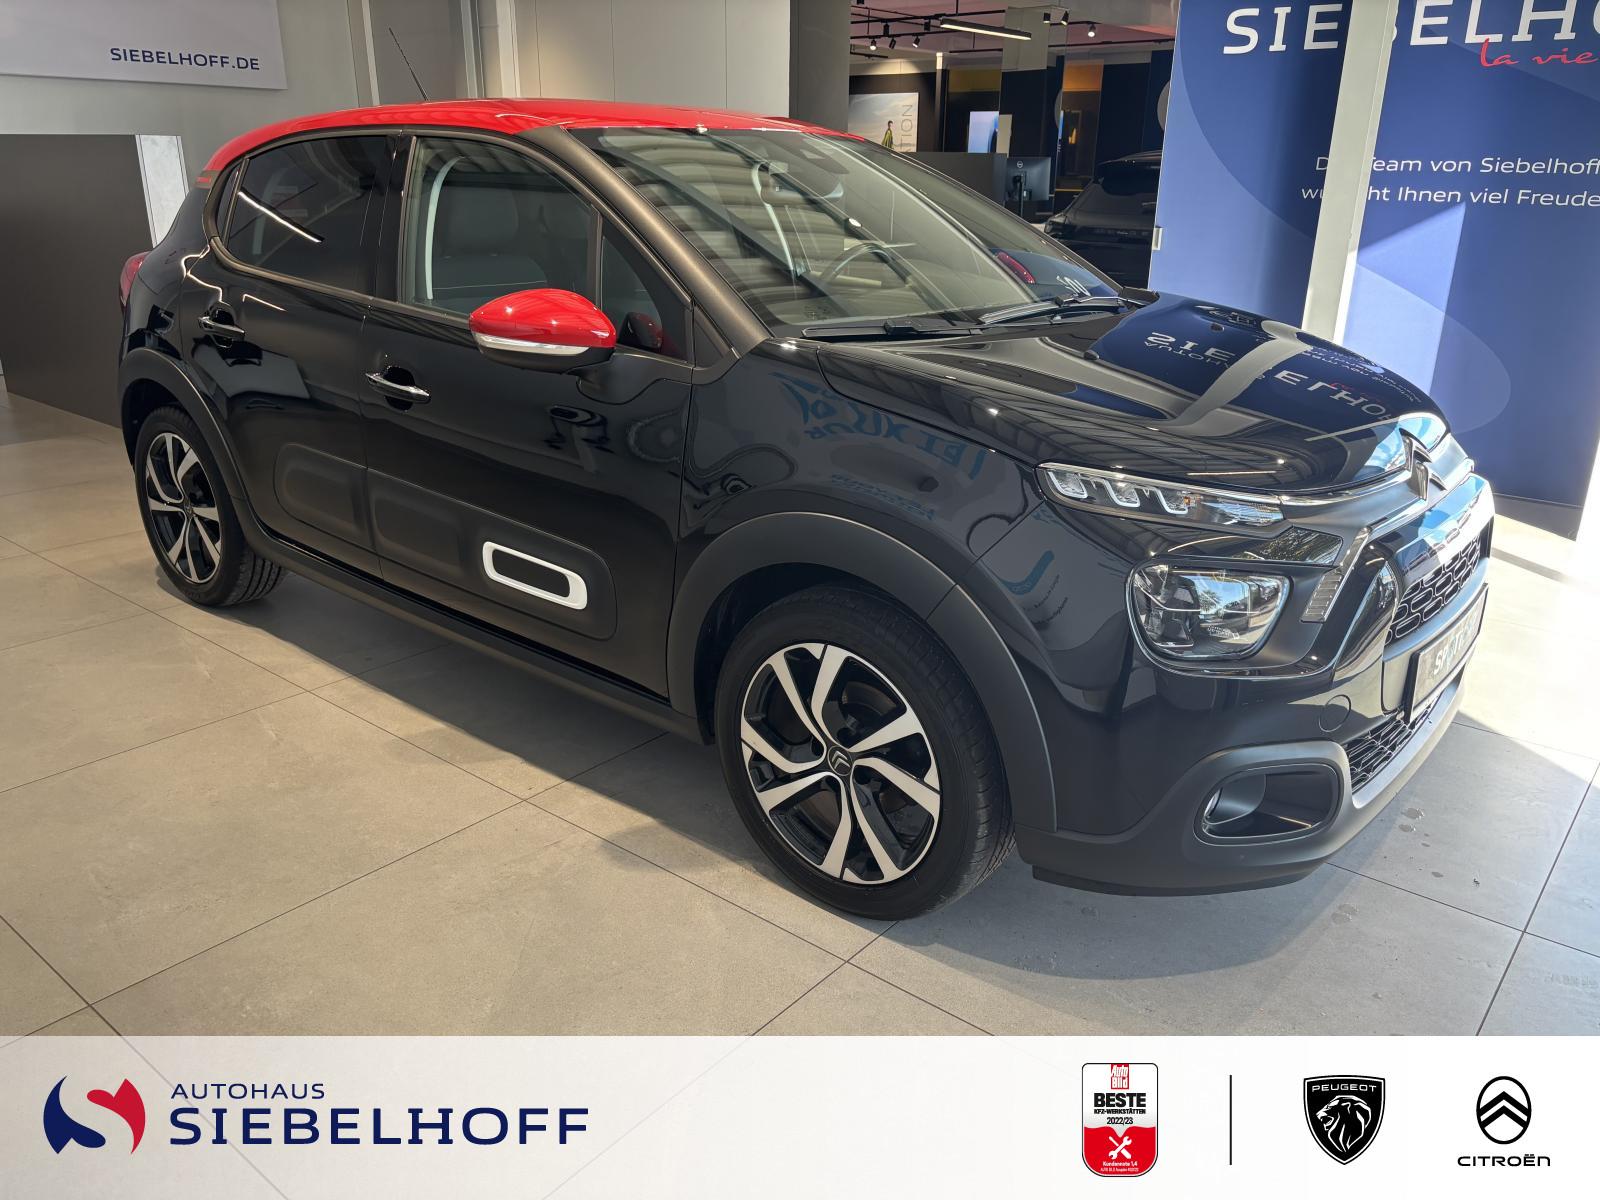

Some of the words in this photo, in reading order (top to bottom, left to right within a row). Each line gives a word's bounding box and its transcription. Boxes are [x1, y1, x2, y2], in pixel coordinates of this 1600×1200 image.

[1223, 0, 1600, 54] SIEELH
[110, 47, 260, 70] SIEBELHOFF.DE
[1480, 37, 1520, 67] la
[901, 104, 913, 152] TION
[1371, 156, 1422, 172] eam
[1430, 160, 1472, 172] von
[1397, 186, 1461, 203] Ihnen
[1469, 188, 1509, 205] viel
[1517, 189, 1600, 207] Freude
